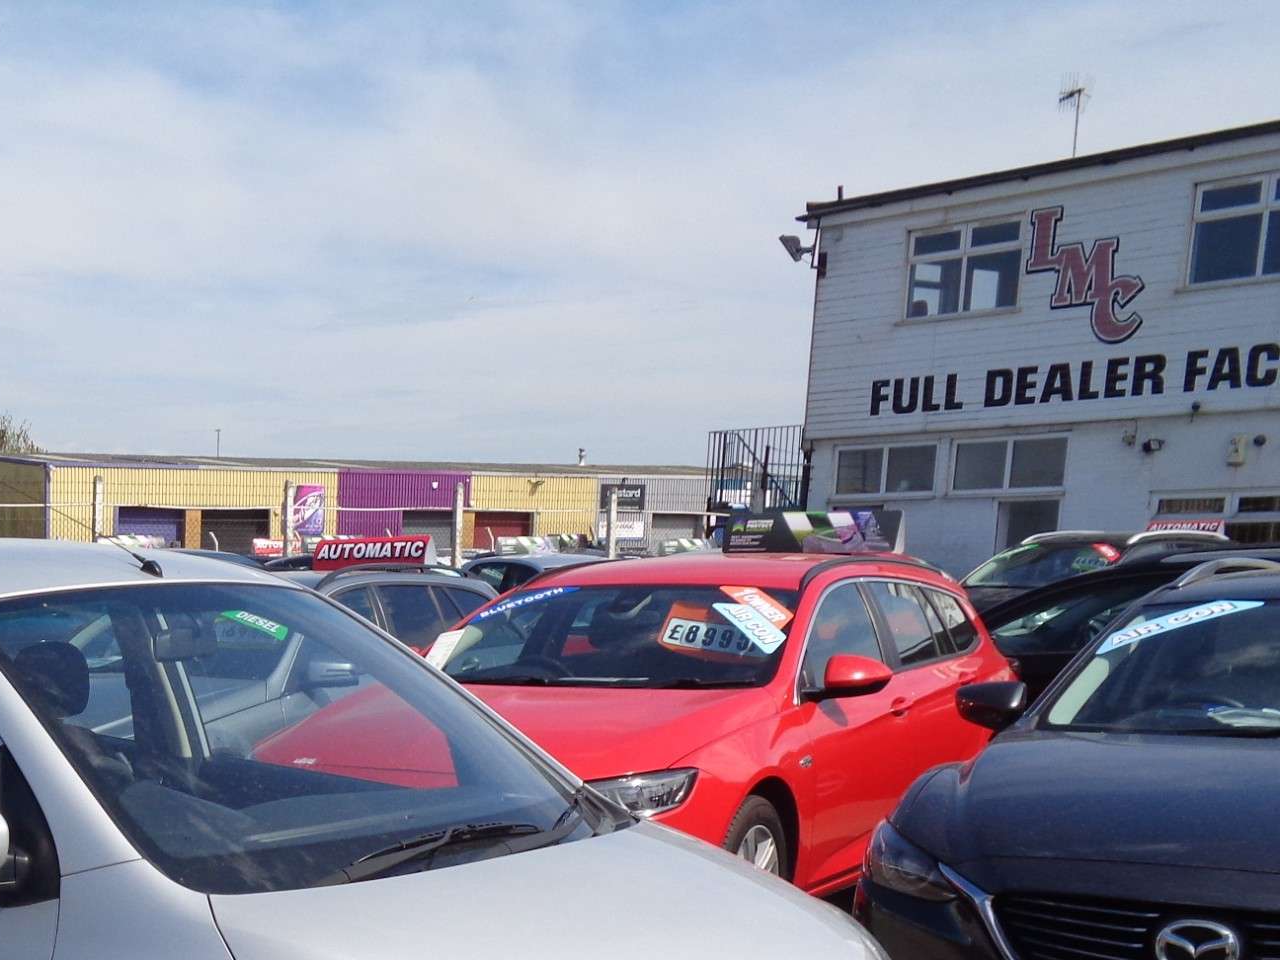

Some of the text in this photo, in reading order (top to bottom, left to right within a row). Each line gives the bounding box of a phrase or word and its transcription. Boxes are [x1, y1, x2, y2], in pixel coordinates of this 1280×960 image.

[1026, 205, 1145, 344] LMC
[870, 343, 1280, 416] FULL DEALER FAC
[317, 541, 425, 561] AUTOMATIC
[235, 610, 281, 633] DIESEL
[479, 587, 565, 618] BLUETOOTH
[1111, 602, 1238, 647] AIR CON
